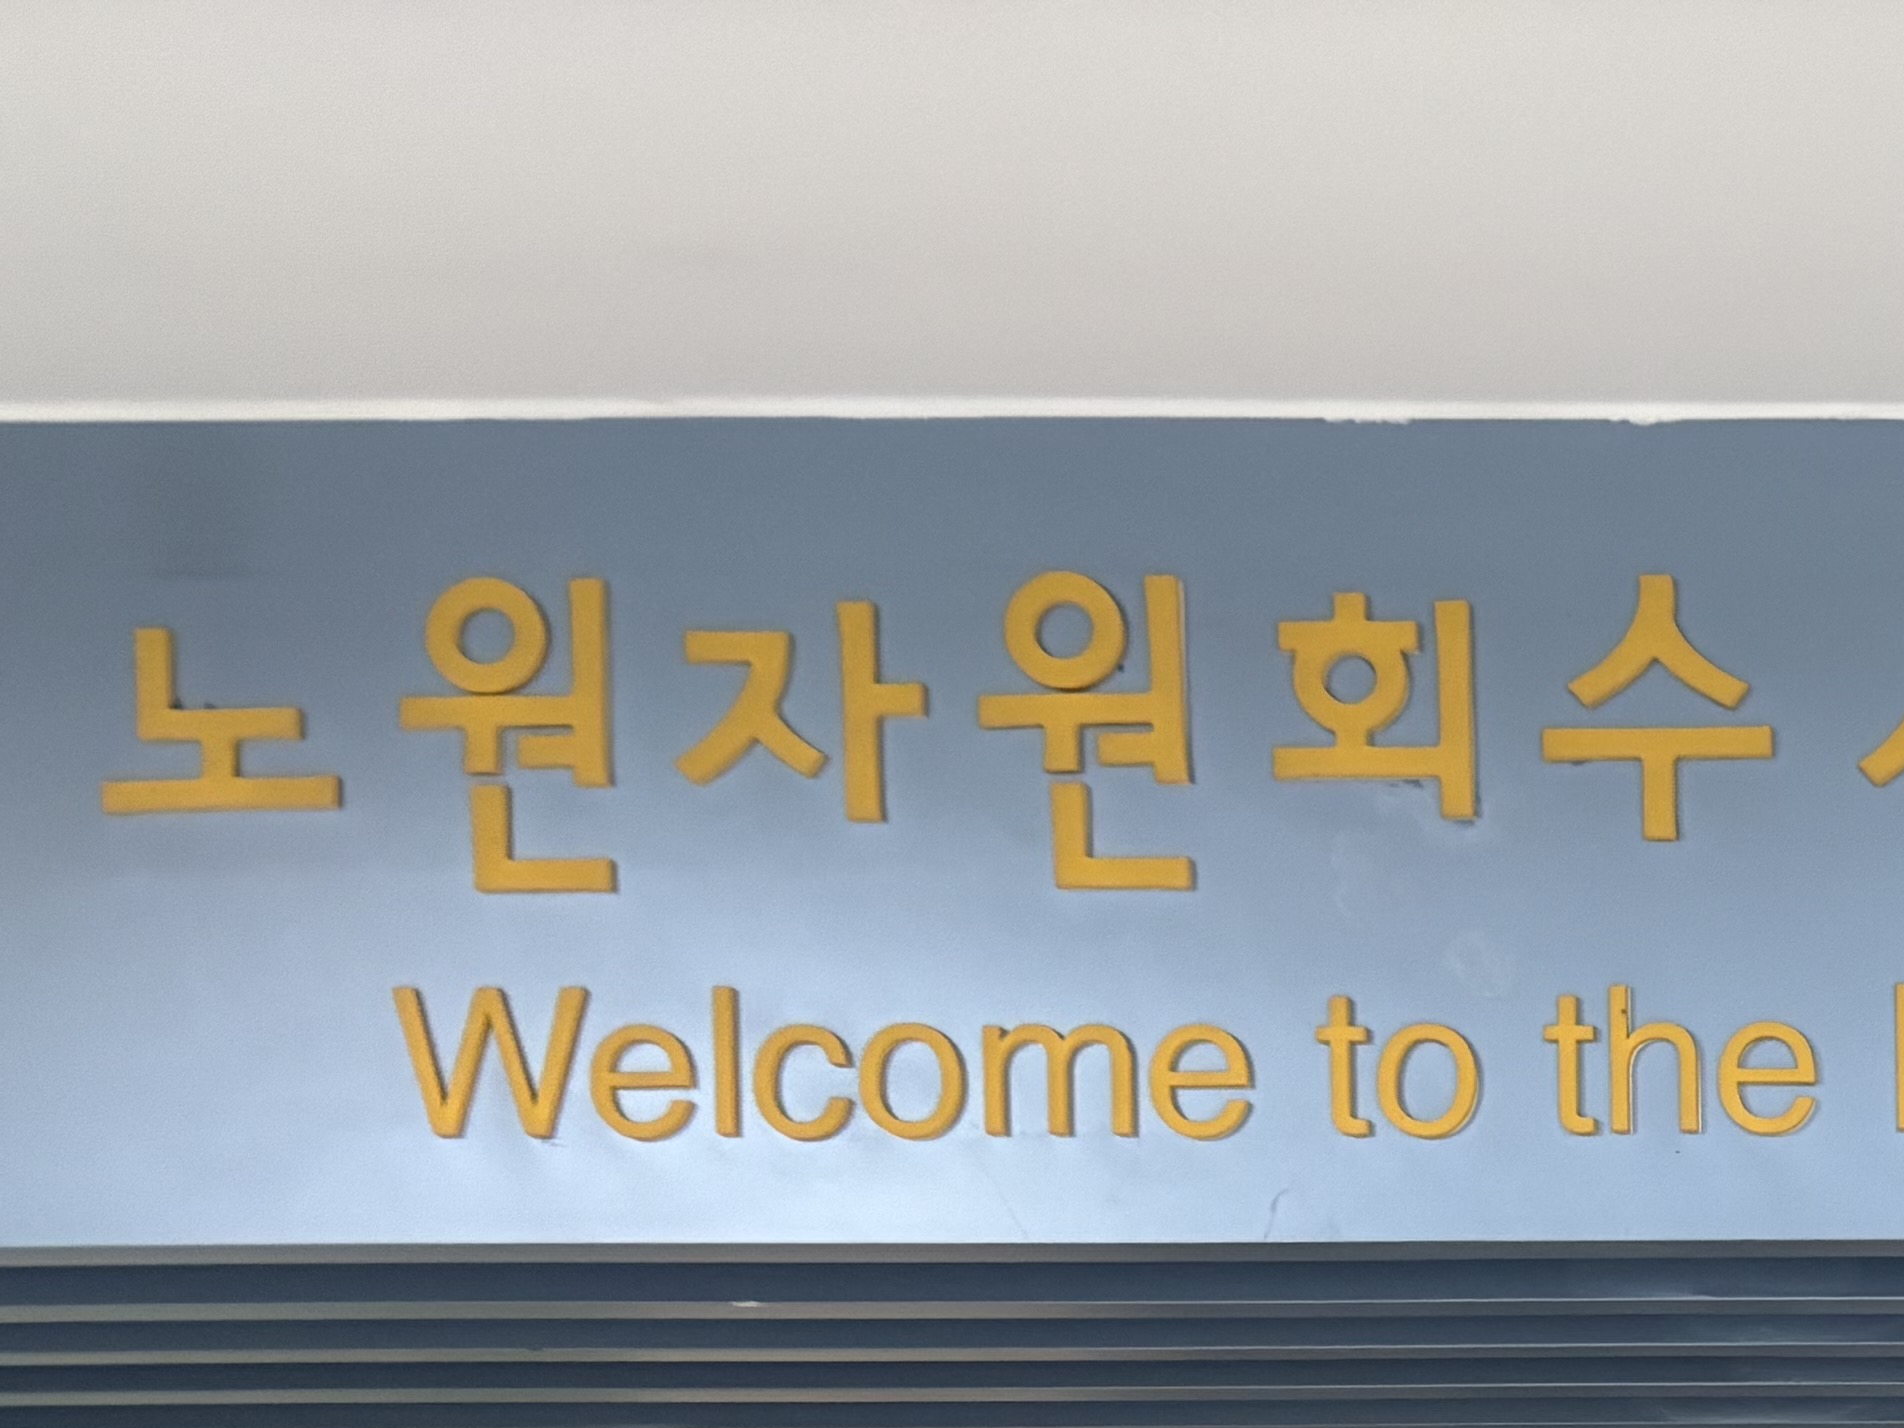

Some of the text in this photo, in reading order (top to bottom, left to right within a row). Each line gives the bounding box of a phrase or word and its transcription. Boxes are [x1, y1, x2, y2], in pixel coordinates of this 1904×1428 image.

[394, 987, 1249, 1140] Welcome
[1318, 998, 1477, 1138] to
[1545, 985, 1817, 1135] the
